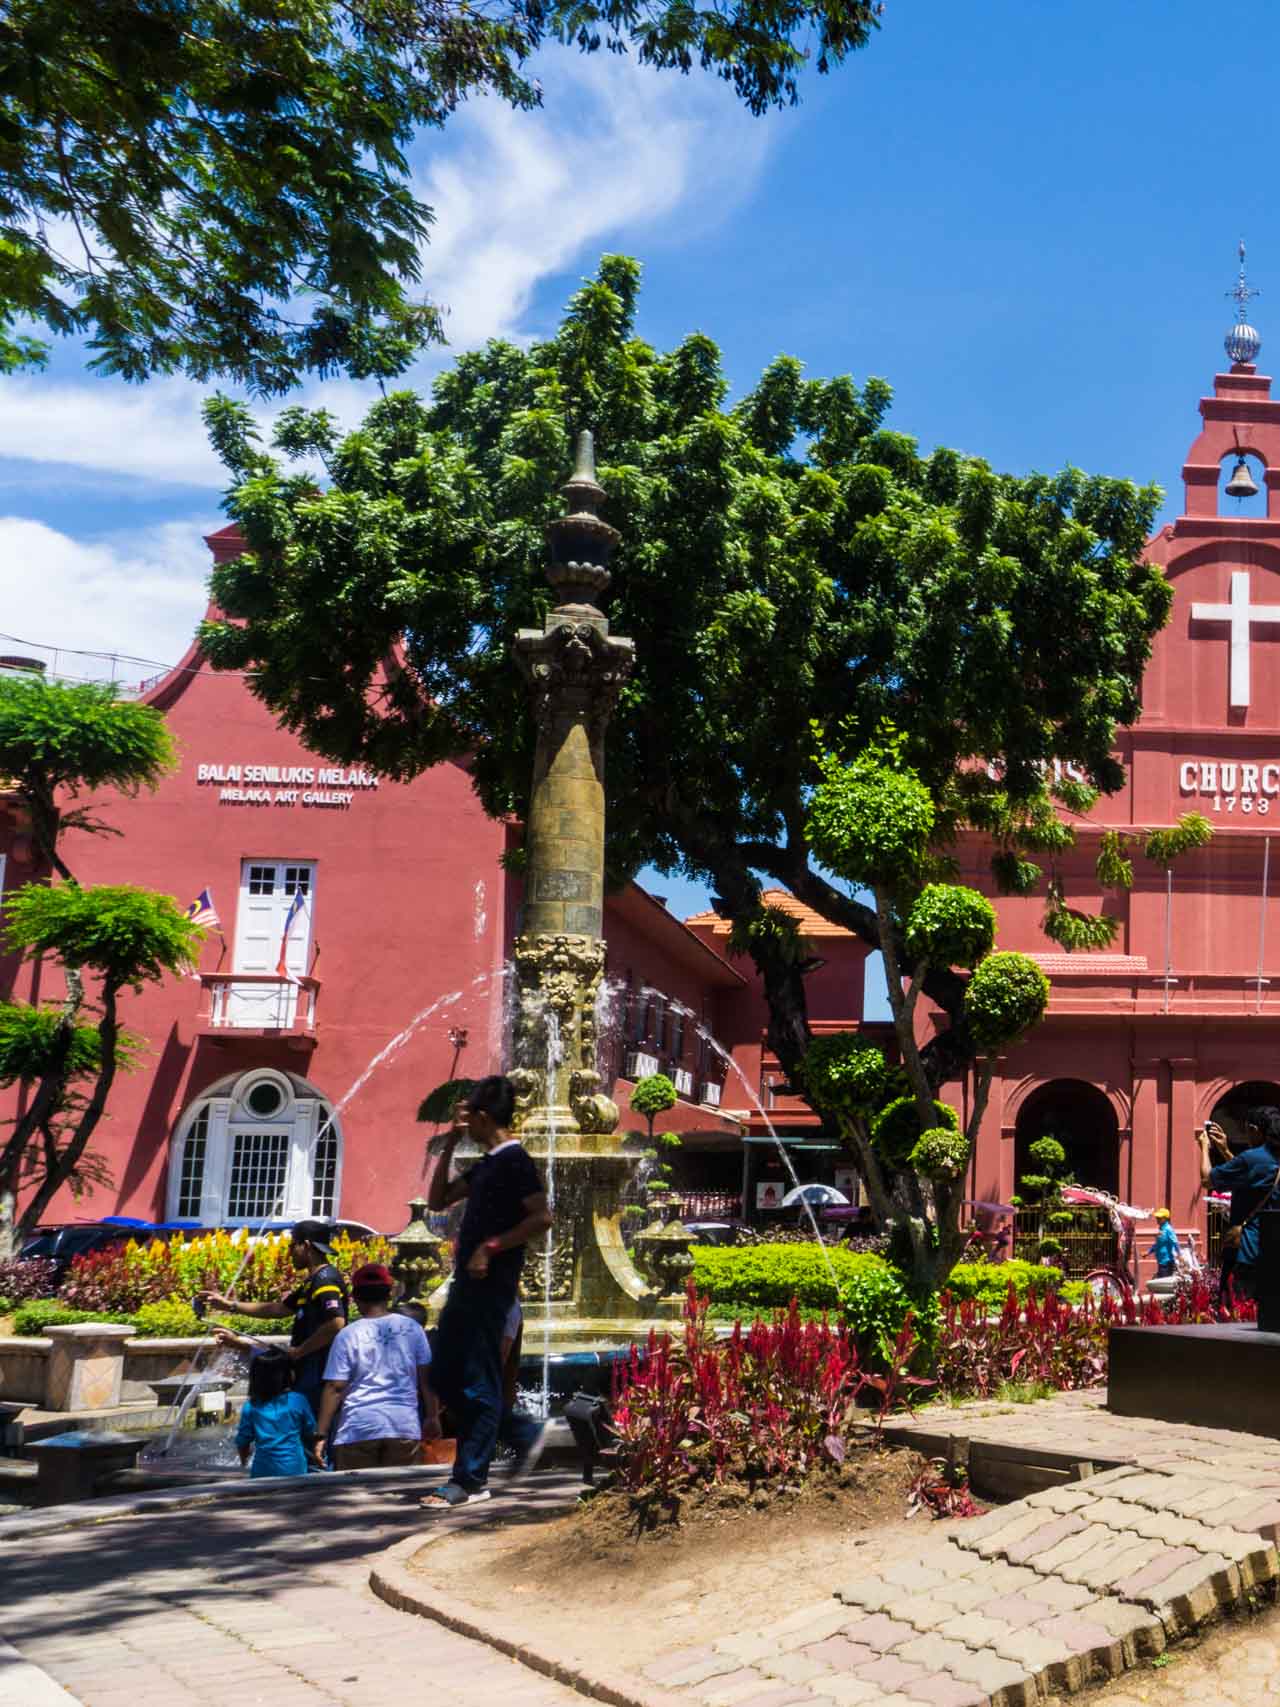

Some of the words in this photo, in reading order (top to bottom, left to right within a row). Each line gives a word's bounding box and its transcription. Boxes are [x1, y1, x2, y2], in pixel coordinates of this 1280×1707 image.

[197, 764, 241, 782] BALAI
[318, 767, 379, 786] MELAKA
[219, 789, 271, 802] MELAKA
[275, 791, 299, 802] ART
[302, 792, 354, 805] GALLERY
[1212, 796, 1269, 813] 1753
